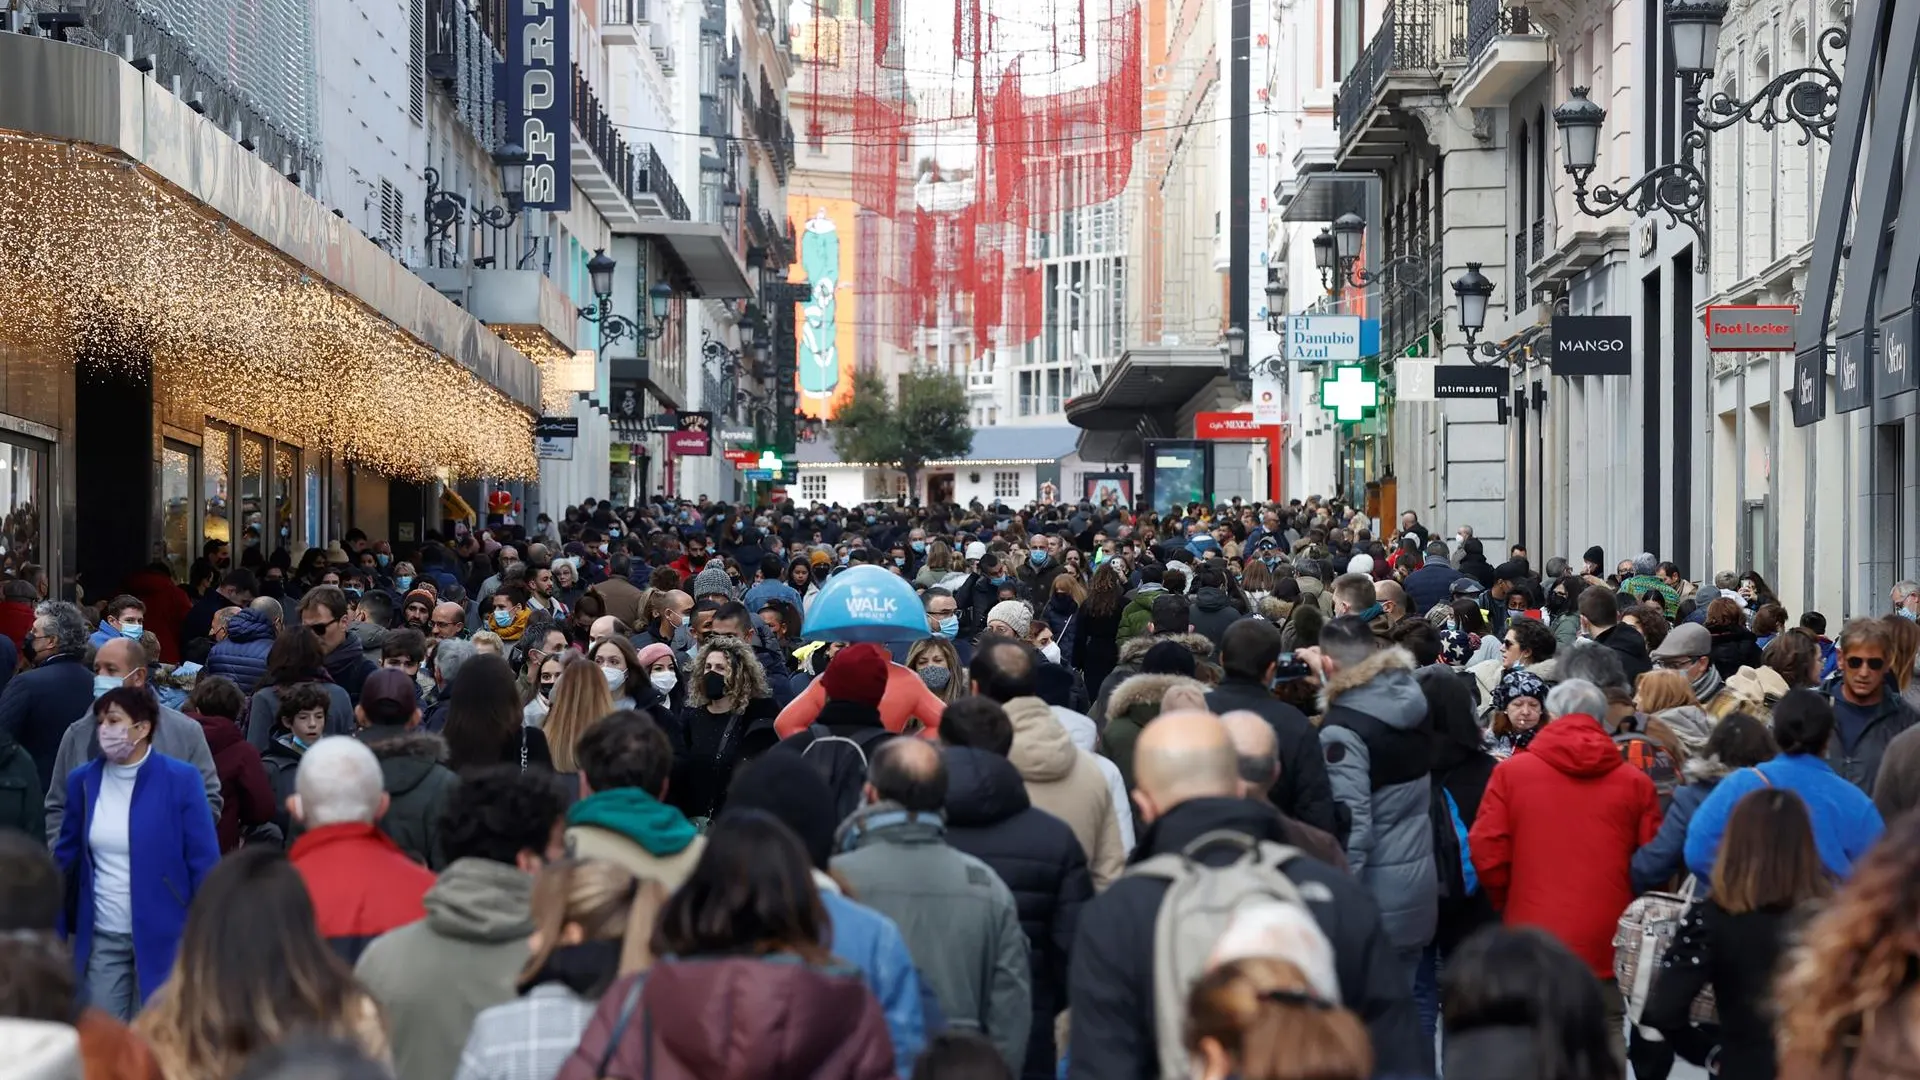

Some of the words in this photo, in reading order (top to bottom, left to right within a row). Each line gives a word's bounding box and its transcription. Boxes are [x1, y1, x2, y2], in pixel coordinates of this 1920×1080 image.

[1256, 143, 1266, 156] 10
[1294, 318, 1310, 331] El
[1714, 323, 1743, 335] Foot
[1746, 322, 1790, 335] Locker
[1294, 331, 1354, 344] Danubio
[1294, 345, 1328, 358] Azul
[1559, 339, 1624, 351] MANGO
[1437, 385, 1498, 393] intimissimi
[845, 597, 898, 612] WALK
